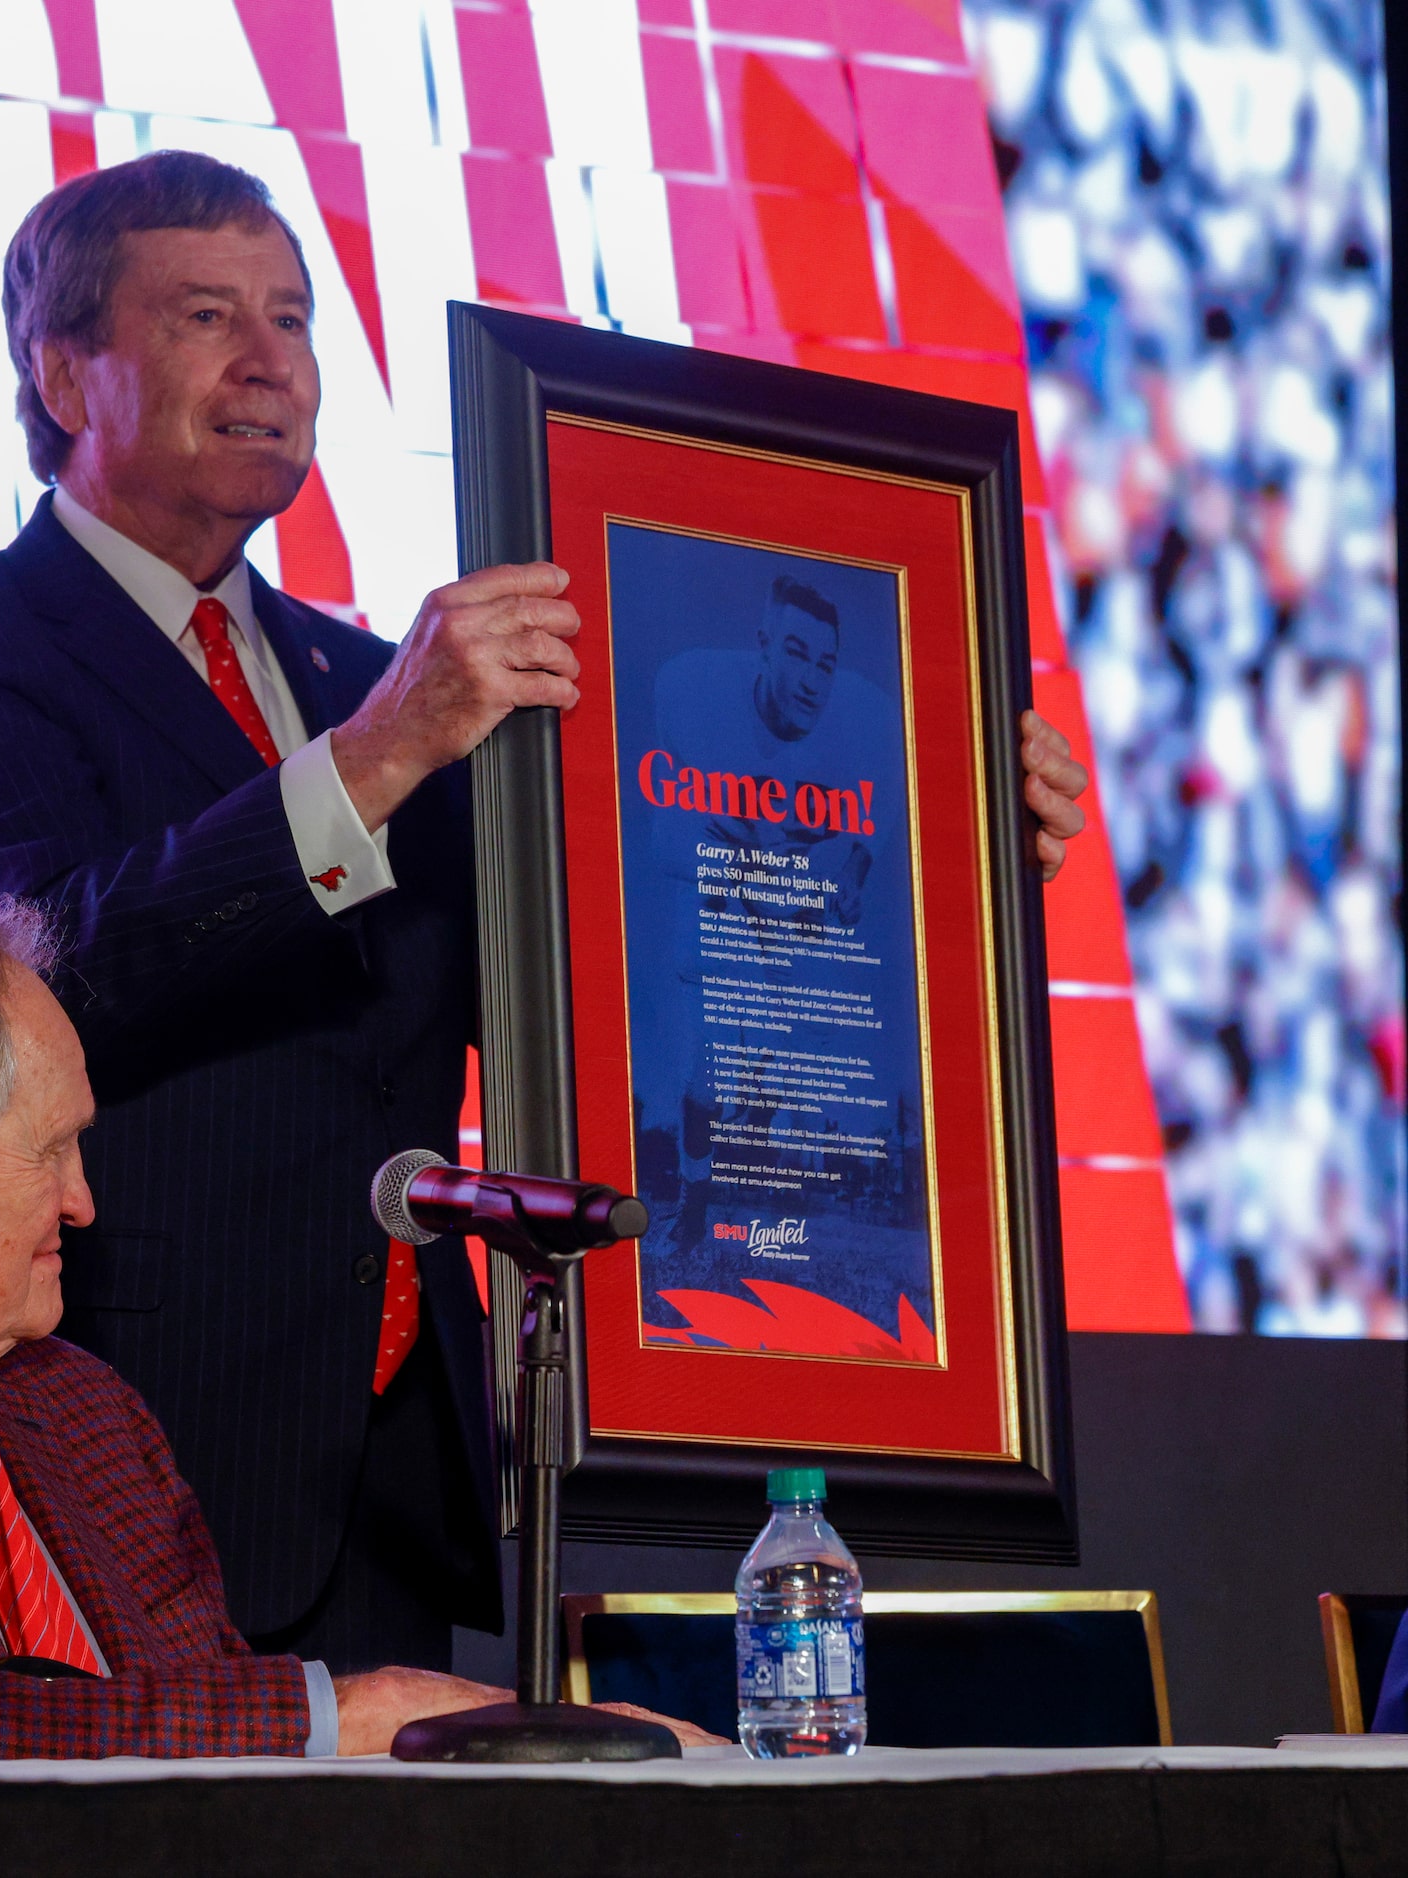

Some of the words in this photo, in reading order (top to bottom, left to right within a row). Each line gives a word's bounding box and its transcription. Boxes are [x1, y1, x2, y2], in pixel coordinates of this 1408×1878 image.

[638, 749, 787, 823] Game
[795, 780, 875, 836] on!
[696, 843, 735, 864] Garry
[736, 848, 750, 863] A.
[751, 850, 789, 868] Weber
[697, 864, 722, 878] gives
[723, 868, 742, 881] $50
[744, 871, 778, 886] million
[780, 876, 791, 887] to
[792, 876, 821, 891] ignite
[822, 880, 838, 894] the
[698, 881, 728, 897] future
[730, 886, 741, 899] of
[742, 888, 785, 907] Mustang
[786, 892, 824, 910] football
[699, 910, 718, 921] Garry
[746, 917, 758, 925] gift
[760, 918, 766, 926] is
[767, 919, 778, 927] the
[779, 920, 802, 930] largest
[803, 923, 810, 931] in
[811, 924, 822, 932] the
[823, 926, 845, 936] history
[700, 923, 716, 932] SMU
[717, 925, 747, 936] Athletics
[748, 930, 758, 938] and
[803, 936, 823, 945] million
[823, 938, 837, 947] drive
[844, 943, 864, 951] expand
[700, 936, 719, 946] Gerald
[725, 939, 737, 948] Ford
[763, 945, 794, 956] continuing
[708, 952, 737, 962] competing
[744, 954, 753, 963] the
[754, 955, 774, 965] highest
[702, 976, 715, 984] Ford
[716, 977, 739, 987] Stadium
[740, 980, 750, 988] has
[750, 981, 763, 992] long
[764, 983, 776, 992] been
[782, 986, 802, 994] symbol
[810, 989, 830, 998] athletic
[860, 995, 871, 1003] and
[703, 989, 727, 1001] Mustang
[745, 994, 755, 1002] and
[756, 995, 765, 1003] the
[765, 996, 782, 1006] Garry
[782, 998, 800, 1007] Weber
[801, 1000, 812, 1009] End
[813, 1002, 826, 1010] Zone
[827, 1004, 851, 1014] Complex
[852, 1006, 862, 1014] will
[863, 1008, 873, 1016] add
[704, 1015, 717, 1024] SMU
[746, 1009, 767, 1017] support
[768, 1011, 786, 1019] spaces
[787, 1012, 798, 1020] that
[799, 1013, 810, 1021] will
[810, 1015, 832, 1024] enhance
[833, 1018, 865, 1027] experiences
[866, 1020, 874, 1029] for
[726, 1045, 746, 1055] seating
[747, 1046, 758, 1054] that
[759, 1047, 775, 1056] offers
[790, 1052, 815, 1061] premium
[816, 1055, 847, 1064] experiences
[848, 1057, 856, 1065] for
[719, 1056, 749, 1068] welcoming
[750, 1061, 777, 1070] concourse
[778, 1063, 789, 1071] that
[790, 1064, 800, 1072] will
[801, 1065, 824, 1075] enhance
[825, 1068, 833, 1076] the
[834, 1068, 843, 1077] fan
[732, 1070, 754, 1080] football
[754, 1075, 783, 1083] operations
[802, 1079, 813, 1087] and
[813, 1079, 830, 1088] locker
[714, 1082, 732, 1092] Sports
[786, 1090, 796, 1098] and
[797, 1092, 819, 1102] training
[819, 1093, 842, 1103] facilities
[843, 1096, 854, 1104] that
[855, 1097, 865, 1105] will
[866, 1100, 887, 1108] support
[723, 1096, 729, 1104] of
[748, 1100, 765, 1109] nearly
[709, 1121, 722, 1130] This
[722, 1123, 742, 1132] project
[743, 1125, 753, 1133] will
[754, 1126, 767, 1134] raise
[768, 1127, 777, 1135] the
[778, 1129, 791, 1137] total
[791, 1129, 804, 1138] SMU
[805, 1130, 815, 1139] has
[816, 1132, 839, 1141] invested
[840, 1134, 845, 1142] in
[710, 1135, 728, 1143] caliber
[729, 1136, 751, 1146] facilities
[752, 1139, 766, 1147] since
[802, 1144, 815, 1152] than
[819, 1147, 840, 1155] quarter
[840, 1147, 846, 1155] of
[850, 1148, 867, 1157] billion
[711, 1161, 730, 1170] Learn
[731, 1164, 748, 1172] more
[763, 1166, 775, 1174] find
[788, 1169, 803, 1177] how
[712, 1174, 738, 1184] involved
[713, 1223, 748, 1241] SMU
[747, 1218, 809, 1257] Ignited
